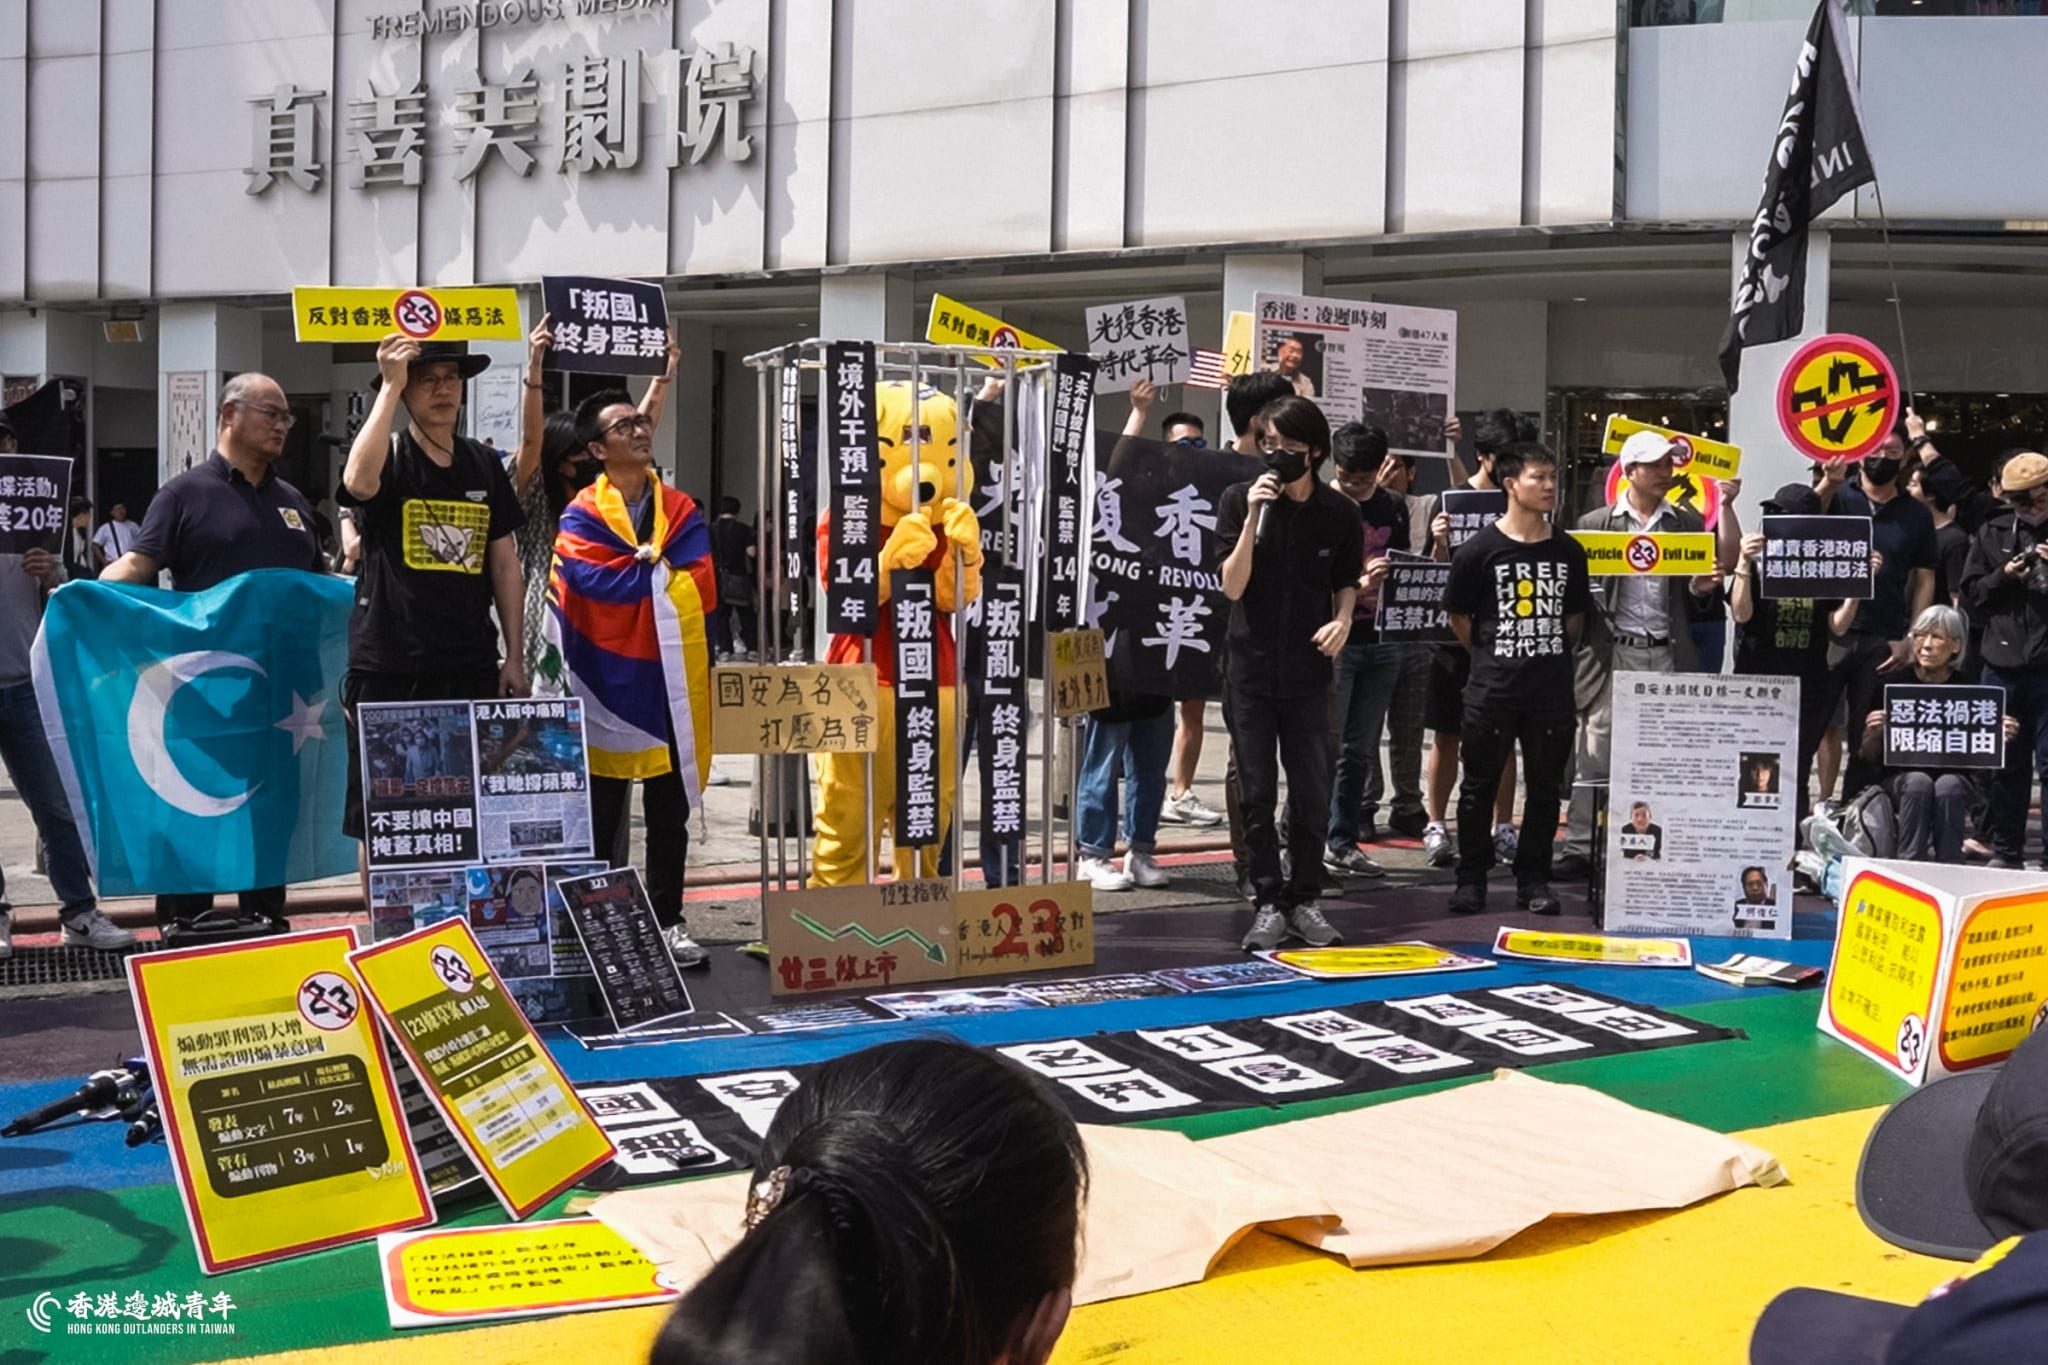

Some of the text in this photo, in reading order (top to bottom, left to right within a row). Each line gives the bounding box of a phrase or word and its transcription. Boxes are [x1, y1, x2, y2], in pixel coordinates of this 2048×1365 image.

[243, 40, 760, 197] 真善美劇院
[566, 289, 648, 323] 「叛國」
[553, 322, 665, 357] 終身監禁
[1090, 305, 1185, 344] 光復香港
[1099, 343, 1187, 382] 時代革命
[1494, 562, 1568, 582] FREE
[1662, 549, 1682, 561] Evil
[1684, 549, 1706, 562] Law
[1394, 586, 1446, 602] 組織的活
[1496, 579, 1567, 600] HONG
[1384, 605, 1449, 631] 監禁14
[1498, 597, 1565, 617] KONG
[718, 671, 833, 708] 國安為名
[896, 582, 935, 839] 「叛國」終身監禁
[983, 582, 1021, 834] 「叛亂」終身監禁
[1890, 699, 1997, 725] 惡法禍港
[759, 712, 875, 752] 打壓為實
[1890, 727, 1996, 754] 限縮自由
[991, 898, 1064, 954] 23
